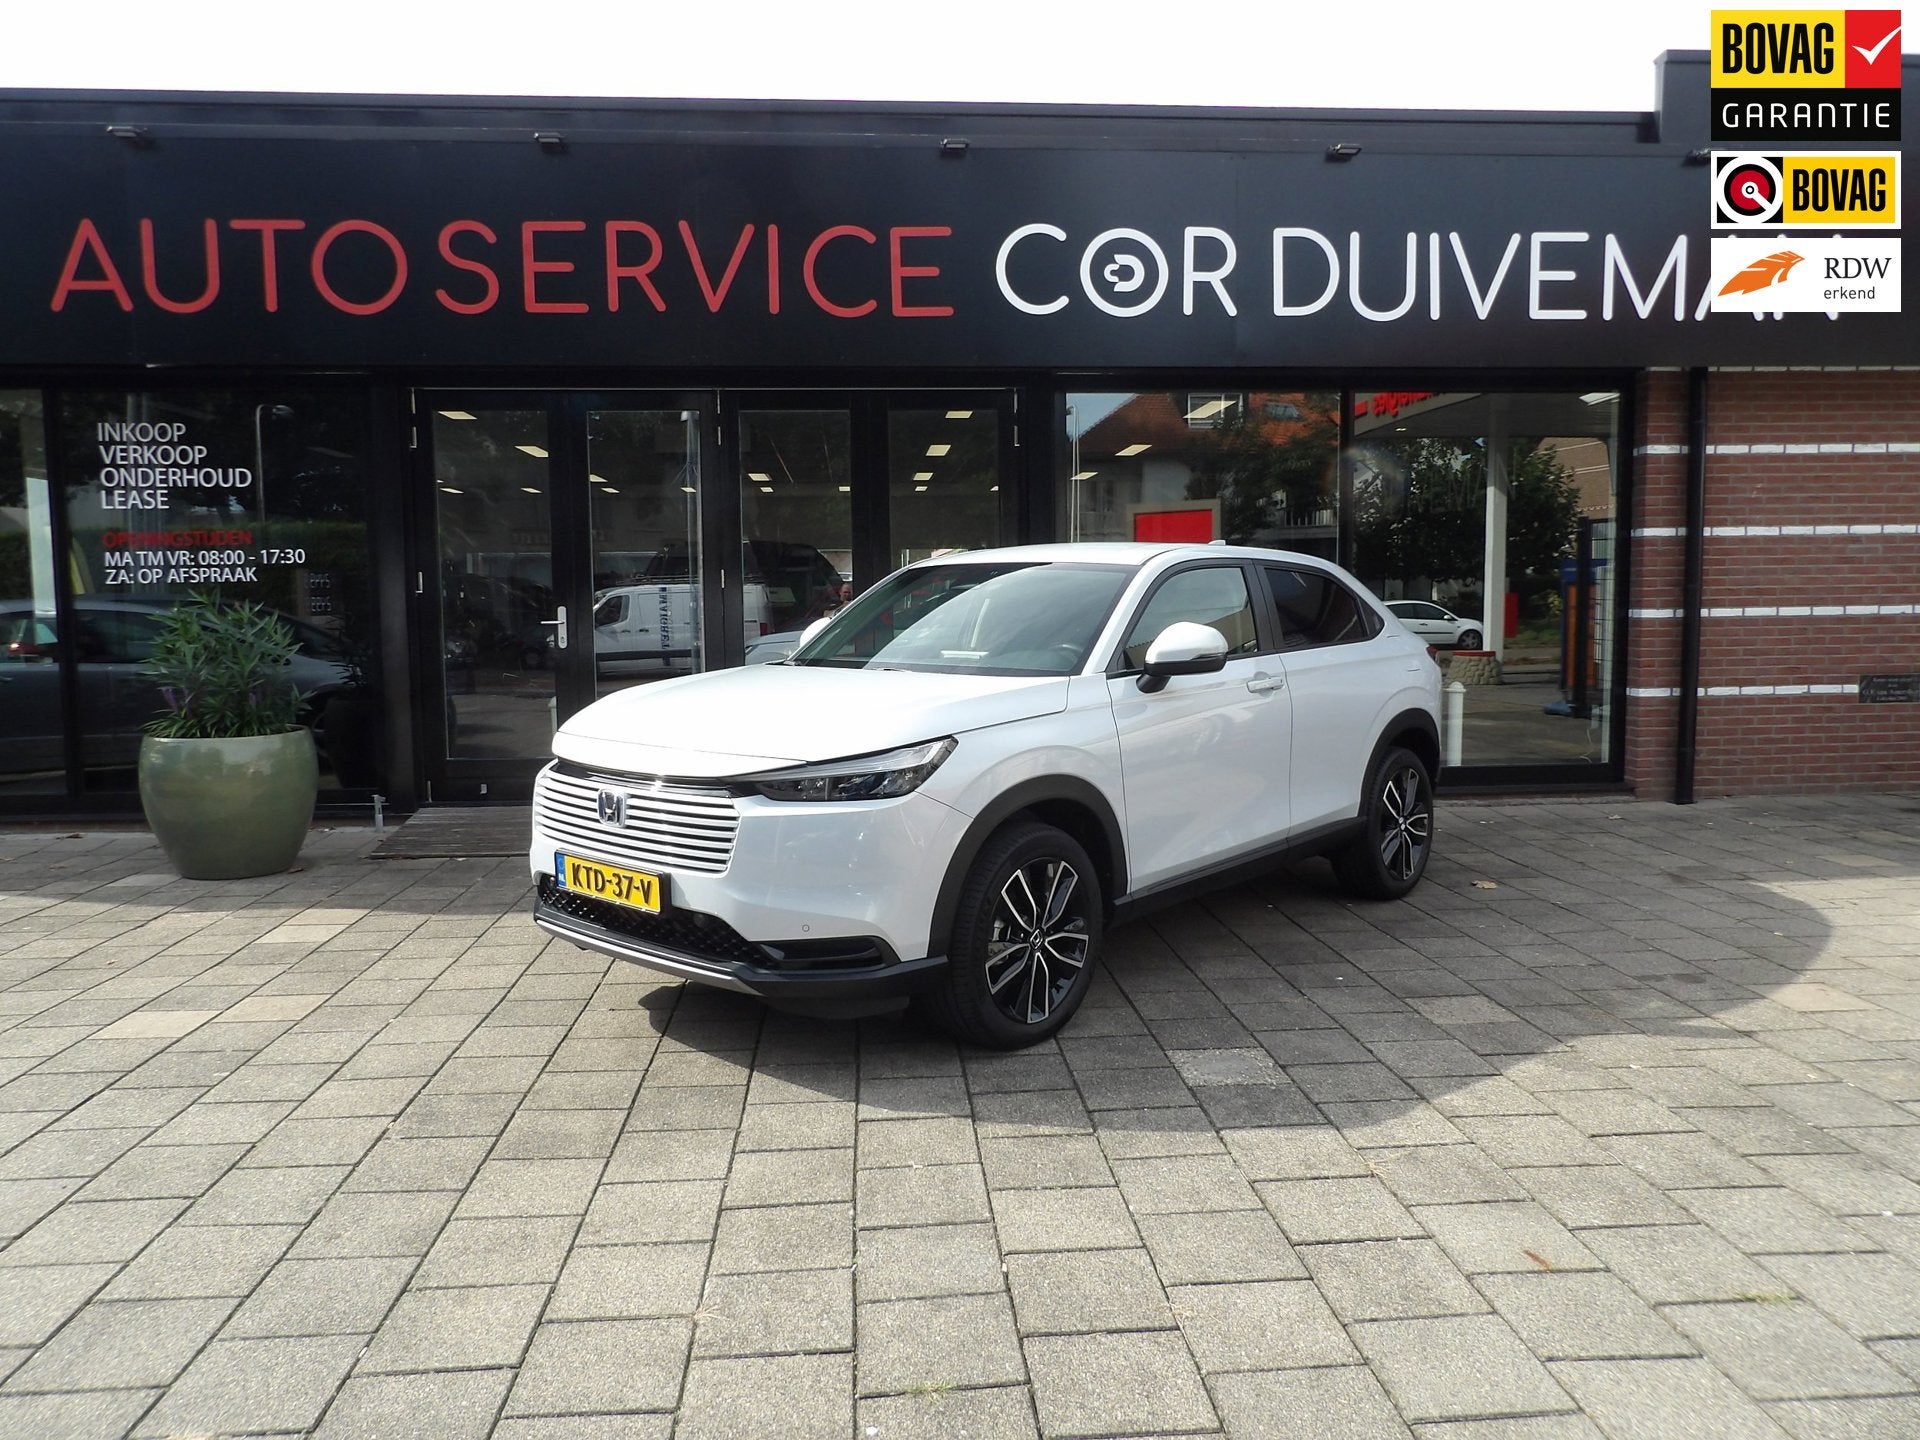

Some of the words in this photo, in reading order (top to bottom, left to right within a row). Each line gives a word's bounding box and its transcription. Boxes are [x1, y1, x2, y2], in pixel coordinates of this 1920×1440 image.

[994, 222, 1238, 318] COR
[1271, 226, 1842, 322] DUIVEM
[97, 422, 187, 443] INKOOP
[98, 445, 208, 465] VERKOOP
[100, 467, 252, 488] ONDERHOUD
[101, 490, 170, 510] LEASE
[104, 552, 134, 567] MA
[136, 551, 163, 567] TM
[167, 551, 195, 566] VR:
[199, 549, 245, 565] 08:00
[260, 548, 306, 564] 17:30
[105, 569, 135, 585] ZA:
[138, 568, 163, 584] OP
[167, 566, 258, 583] AFSPRAAK
[571, 862, 653, 906] KTD-37-V
